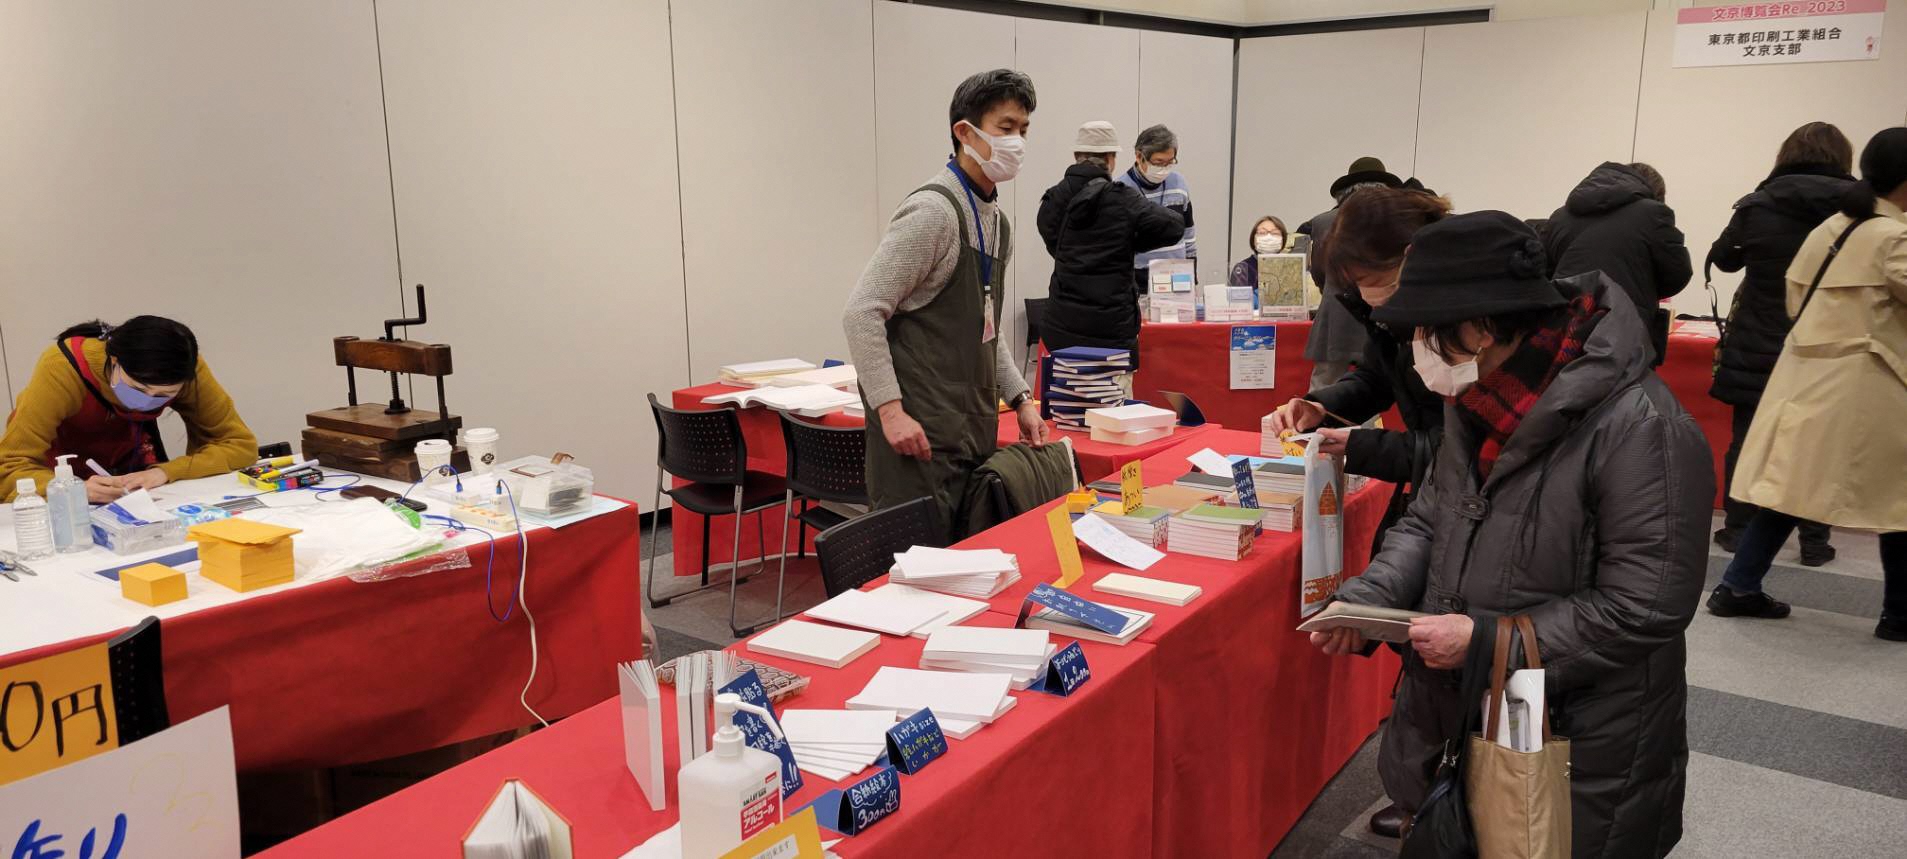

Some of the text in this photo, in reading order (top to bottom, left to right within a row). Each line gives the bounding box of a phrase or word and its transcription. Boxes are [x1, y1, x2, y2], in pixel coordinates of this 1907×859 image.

[1807, 1, 1845, 14] 2023
[1708, 27, 1842, 46] 東京都印刷工業組合
[1743, 43, 1802, 57] 文京支部
[743, 803, 775, 829] アルコール
